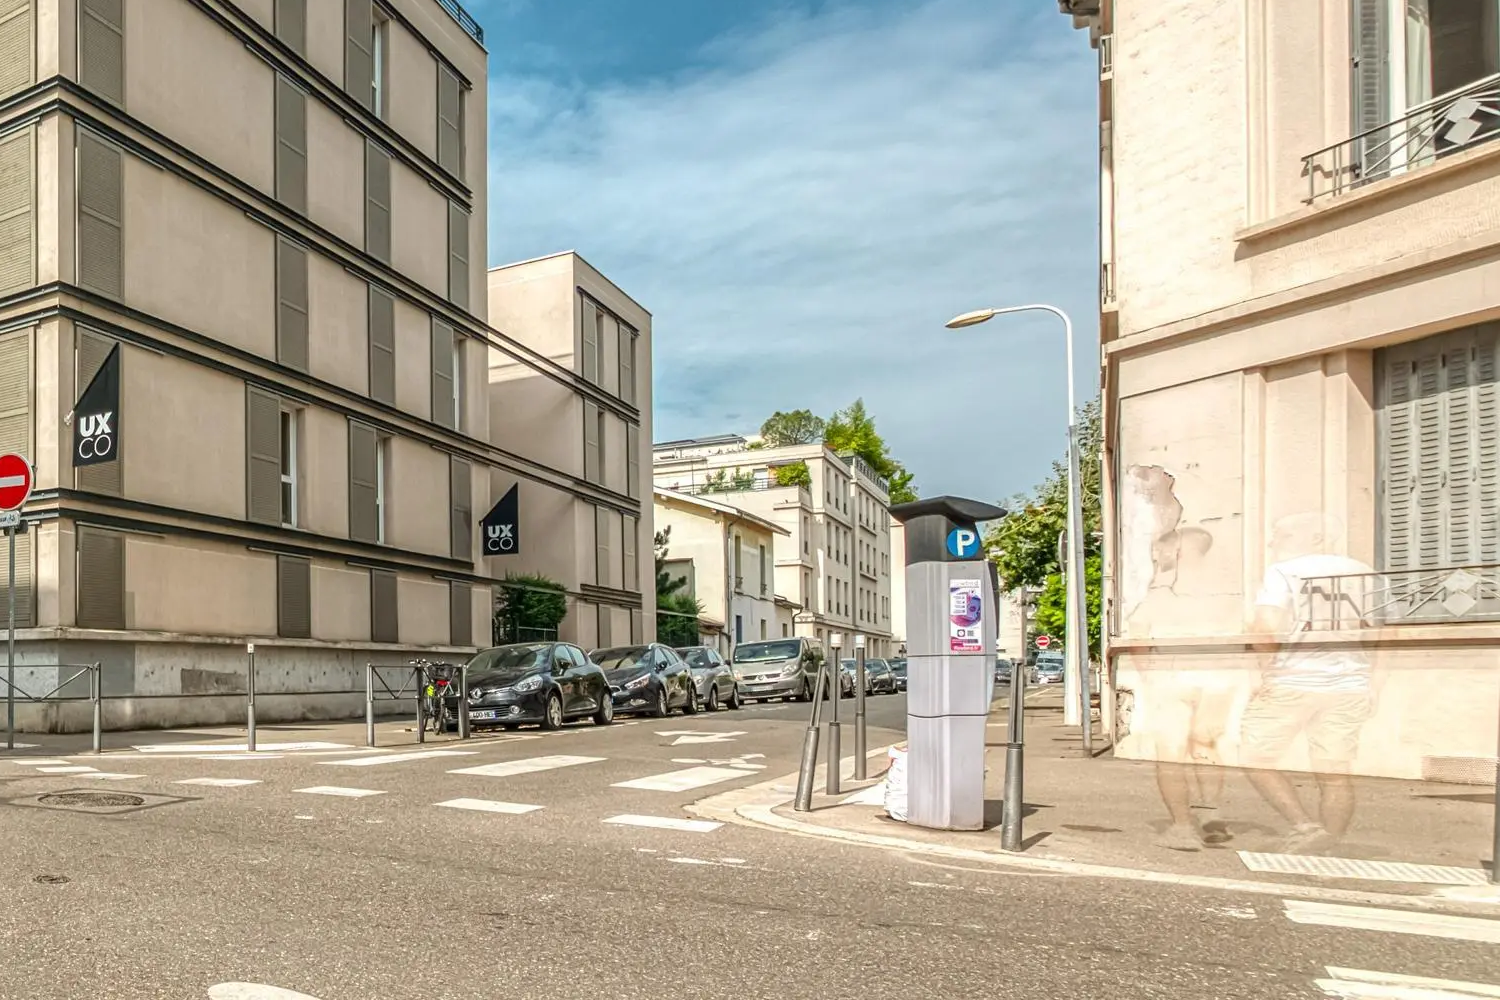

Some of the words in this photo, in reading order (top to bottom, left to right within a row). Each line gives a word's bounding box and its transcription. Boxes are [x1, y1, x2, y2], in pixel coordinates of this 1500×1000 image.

[80, 411, 112, 437] UX
[79, 434, 111, 458] CO
[487, 524, 513, 538] UX
[957, 530, 975, 556] P
[488, 537, 513, 551] CO
